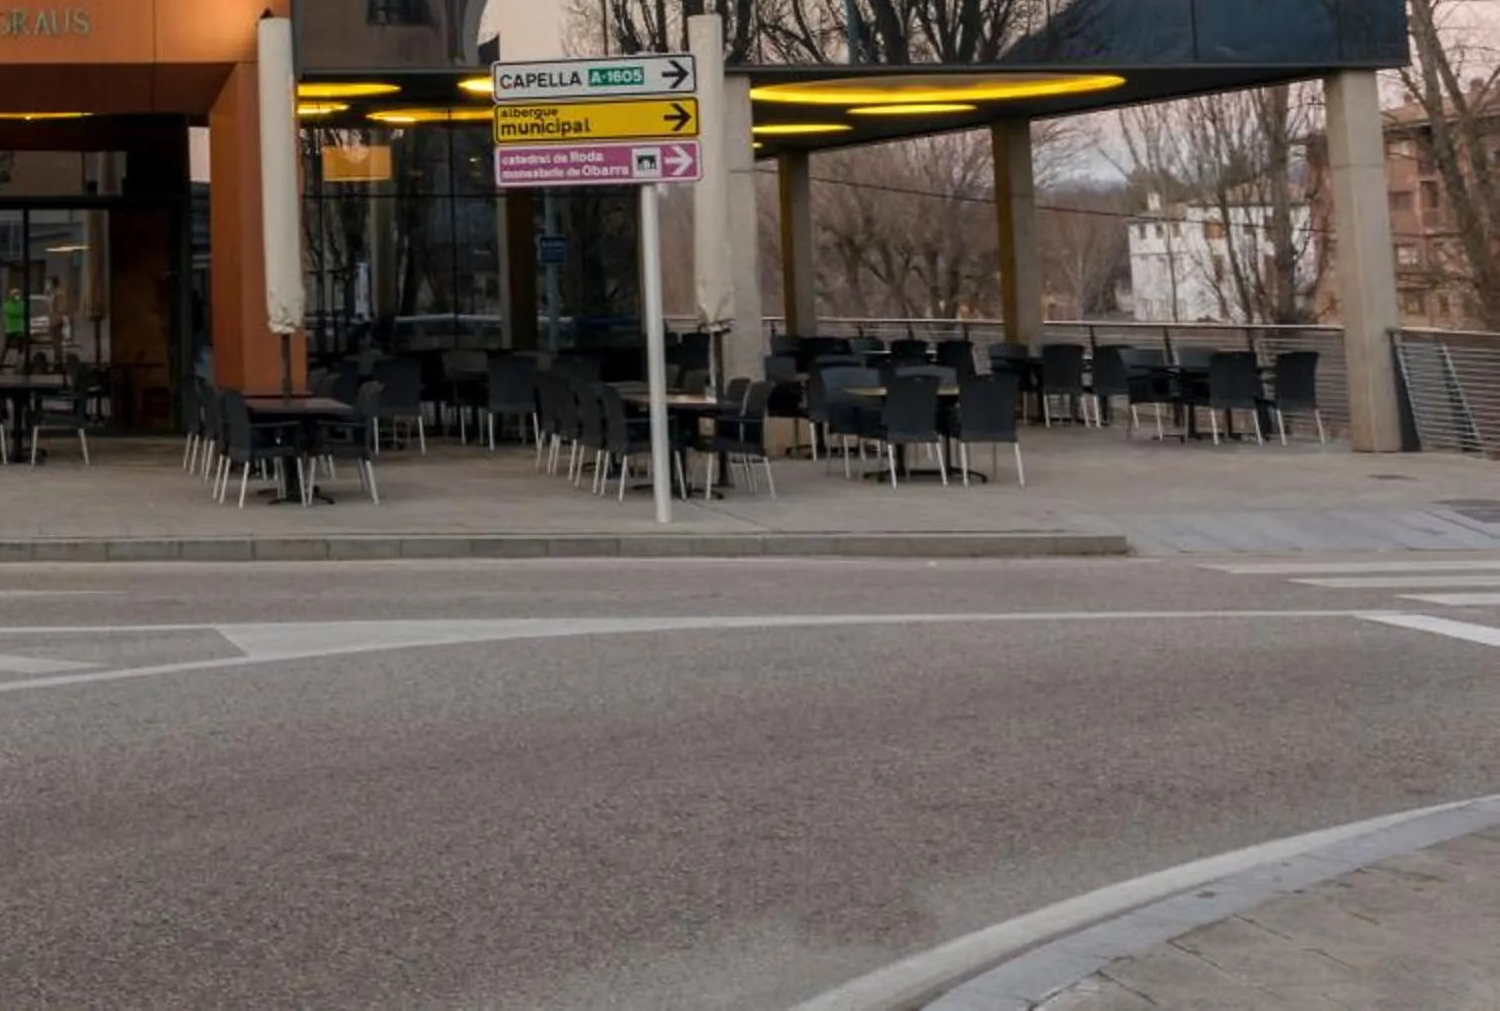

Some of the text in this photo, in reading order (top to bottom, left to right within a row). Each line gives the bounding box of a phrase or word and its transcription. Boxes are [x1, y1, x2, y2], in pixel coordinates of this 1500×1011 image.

[500, 68, 643, 90] CAPELLA A-1605
[501, 119, 590, 137] municipal
[569, 150, 604, 162] Roda
